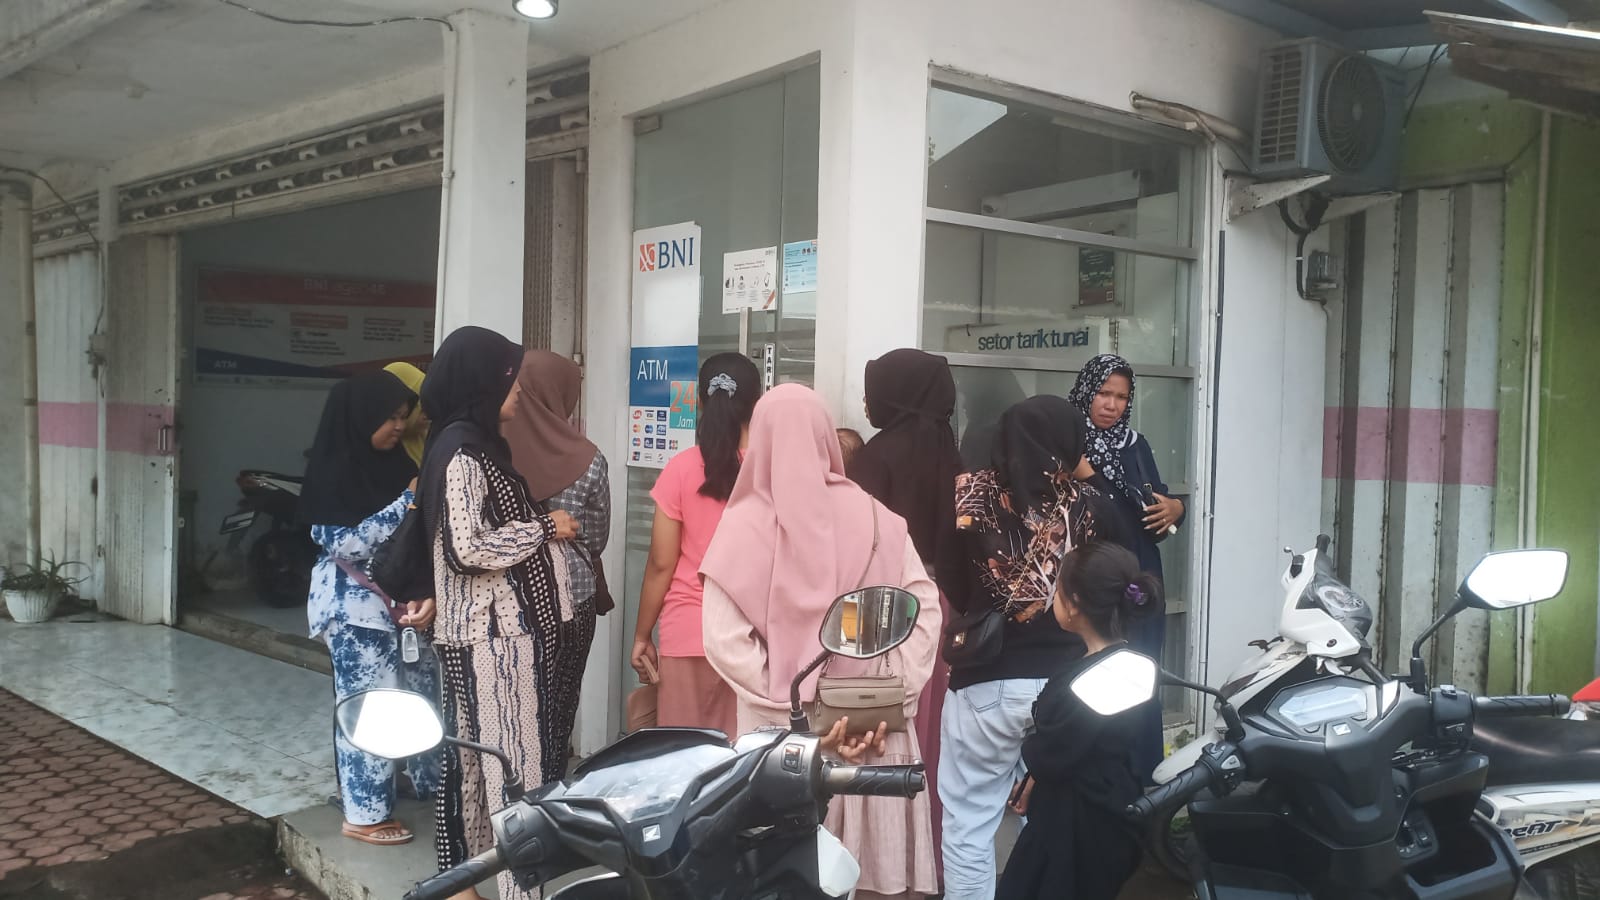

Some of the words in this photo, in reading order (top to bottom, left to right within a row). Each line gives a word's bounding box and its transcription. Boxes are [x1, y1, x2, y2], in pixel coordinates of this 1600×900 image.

[658, 237, 694, 269] BNI
[978, 333, 1014, 350] setor
[1016, 328, 1050, 349] tarik
[1051, 327, 1089, 348] tunai
[213, 360, 237, 369] ATM
[637, 360, 668, 381] ATM
[670, 381, 696, 413] 24
[677, 416, 693, 428] Jam
